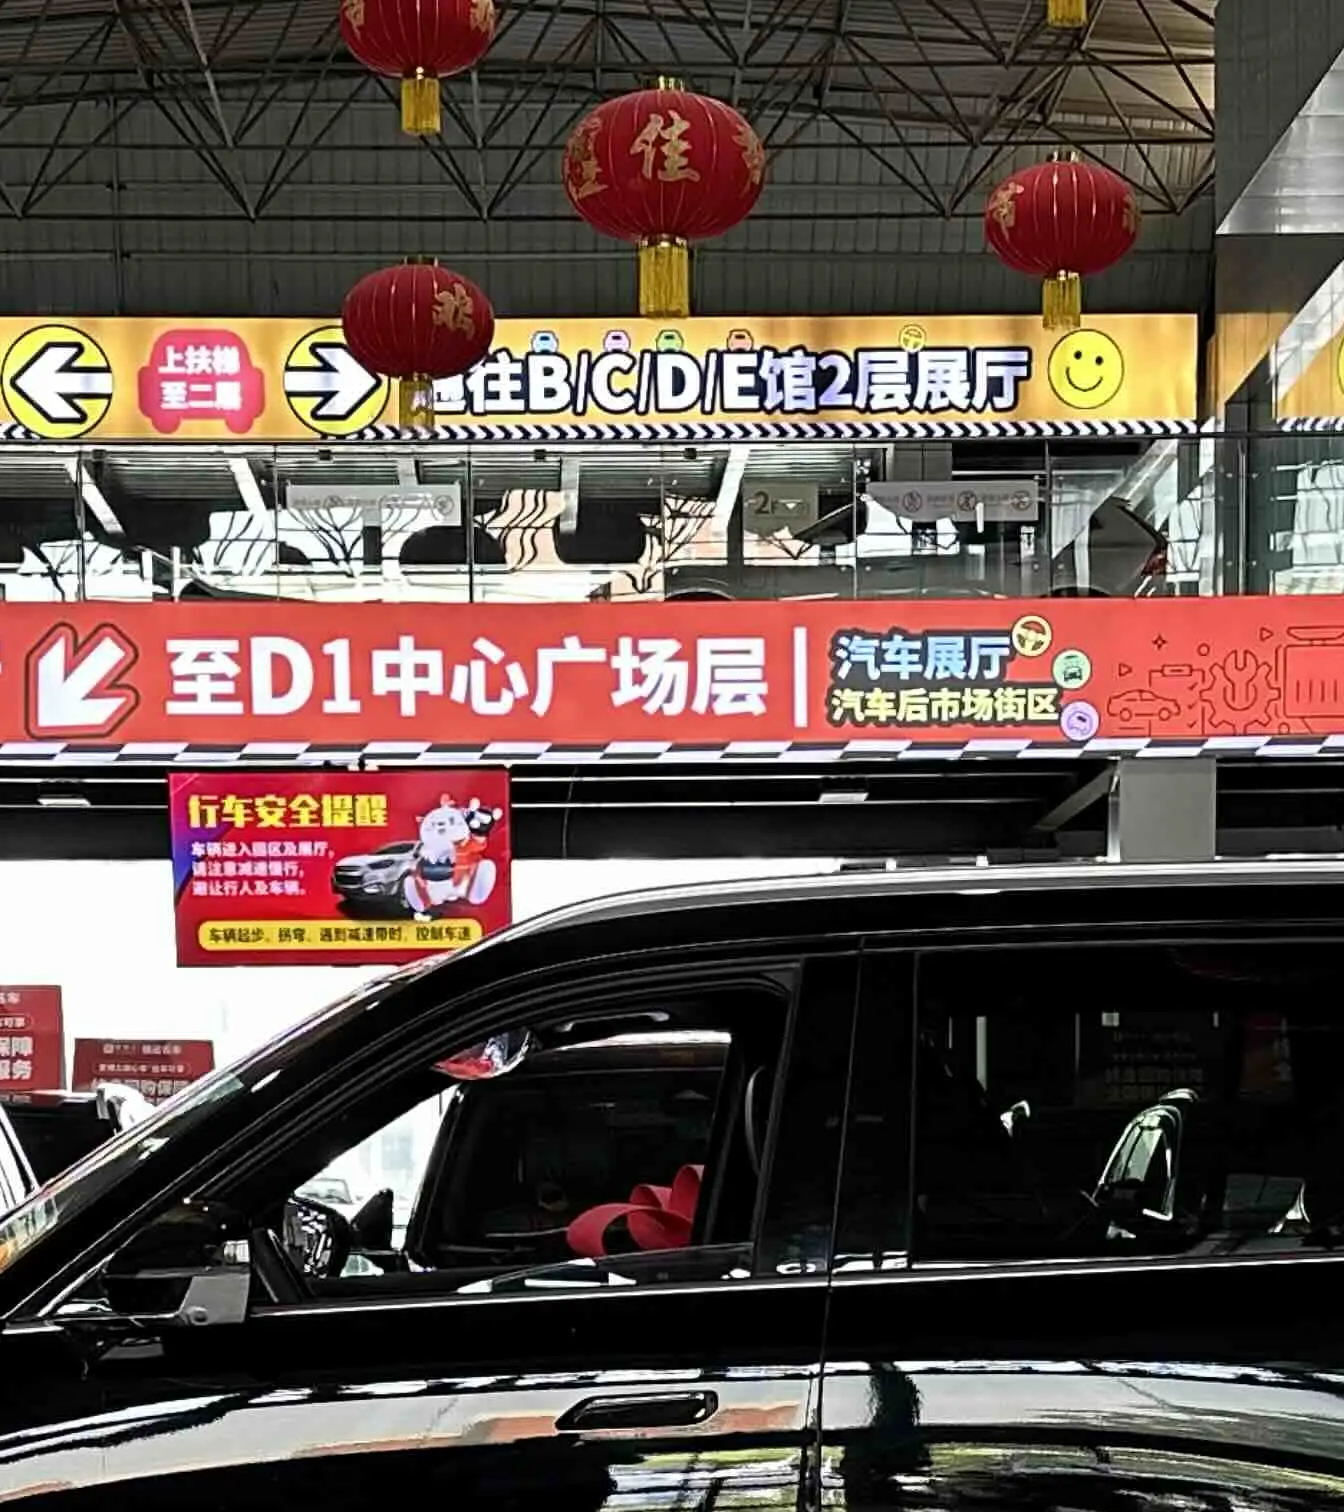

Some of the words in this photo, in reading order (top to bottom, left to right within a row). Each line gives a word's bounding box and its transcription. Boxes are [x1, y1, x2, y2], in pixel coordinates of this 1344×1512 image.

[157, 344, 242, 376] 上扶梯
[159, 380, 243, 411] 至二层
[836, 634, 1011, 681] 汽车展厅
[165, 635, 769, 718] 至D1中心广场层
[830, 686, 1060, 723] 汽车后市场街区
[188, 793, 389, 829] 行车安全提醒
